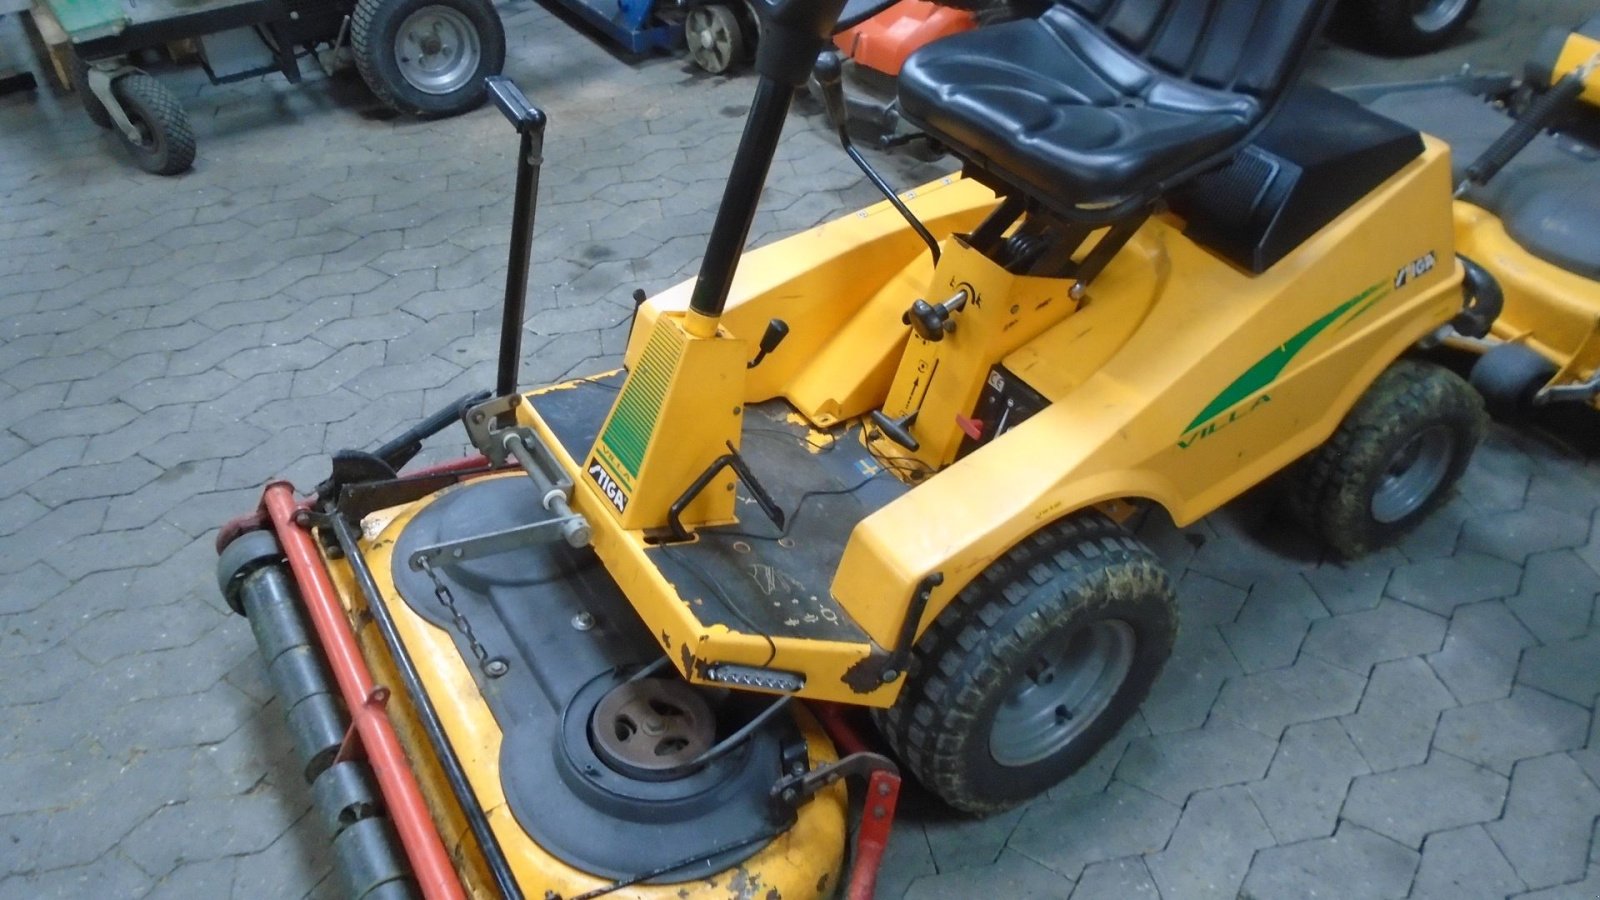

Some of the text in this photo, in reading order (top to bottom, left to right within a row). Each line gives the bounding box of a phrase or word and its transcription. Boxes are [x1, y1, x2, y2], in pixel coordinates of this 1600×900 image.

[1177, 394, 1271, 449] VILLA
[588, 463, 625, 513] STIGA
[602, 444, 630, 482] VILLA
